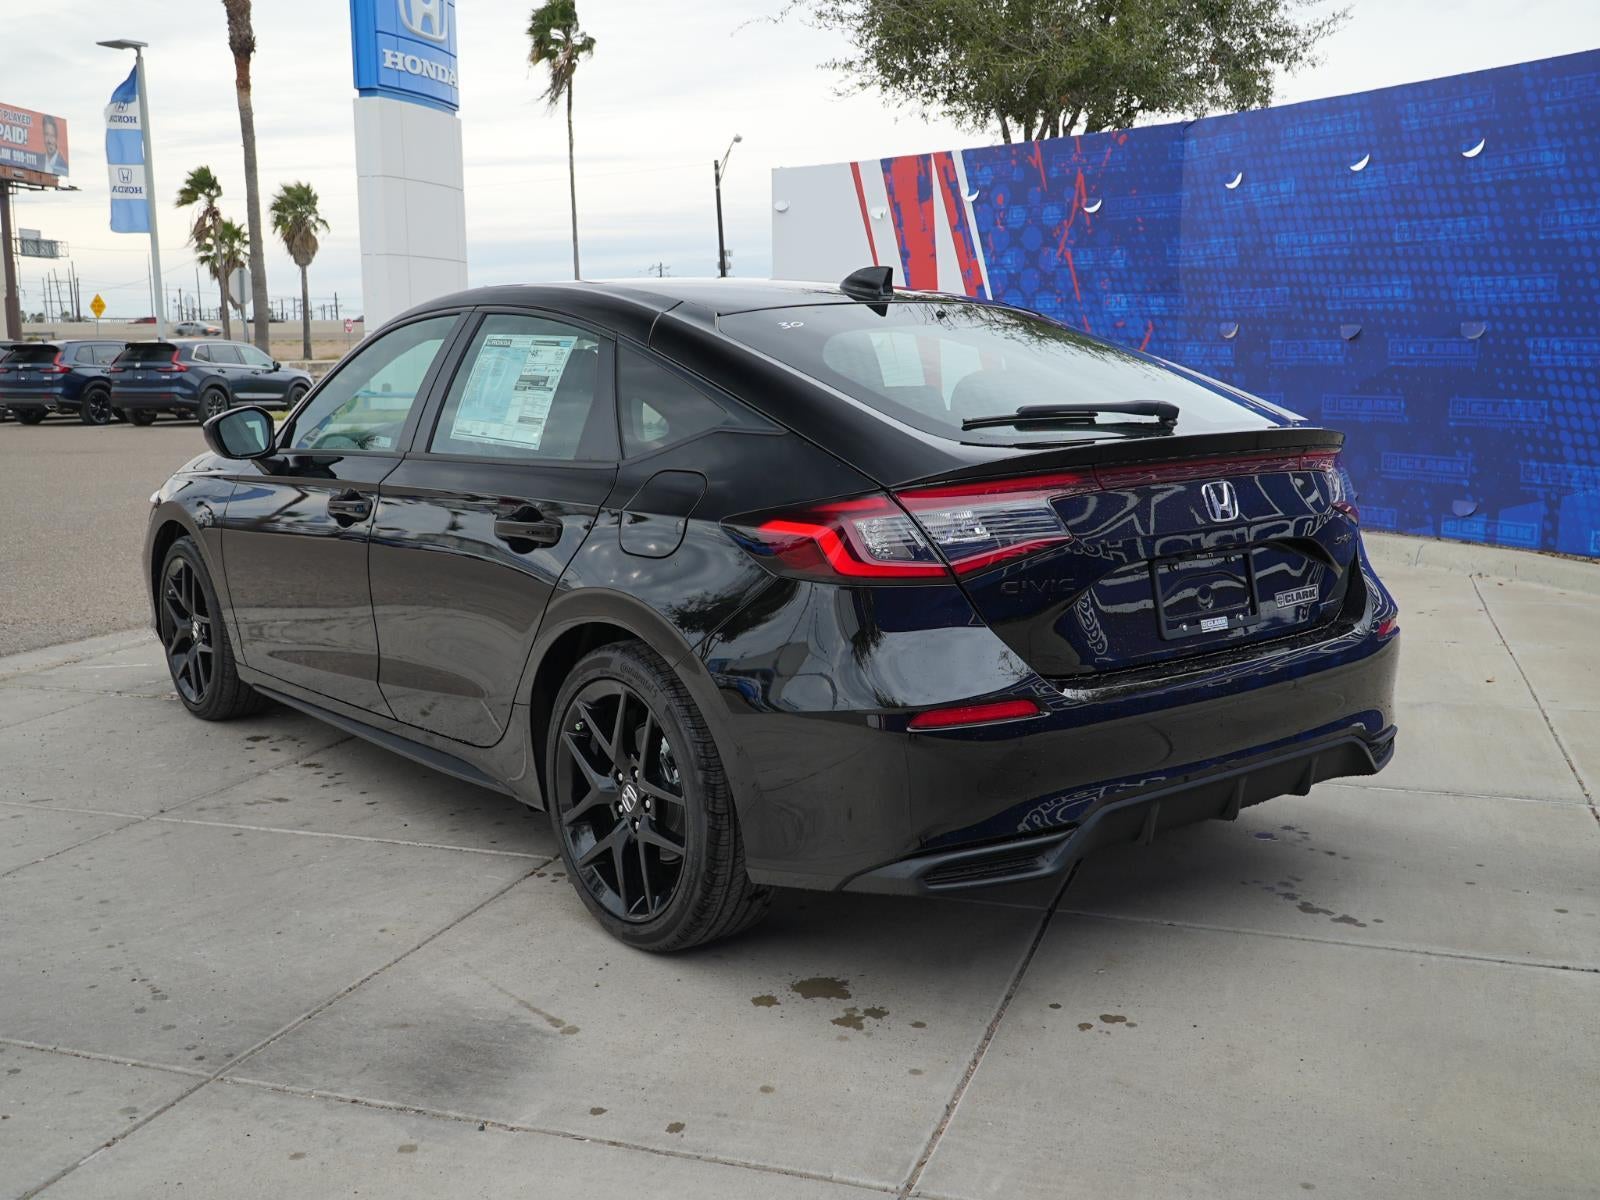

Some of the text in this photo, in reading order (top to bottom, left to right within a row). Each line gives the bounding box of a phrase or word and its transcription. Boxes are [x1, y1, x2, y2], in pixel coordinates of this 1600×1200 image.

[382, 48, 458, 89] HONDA
[3, 110, 32, 125] PLAYED
[778, 321, 804, 329] 30
[1000, 578, 1076, 594] CIVIC
[1285, 588, 1316, 604] CLARK
